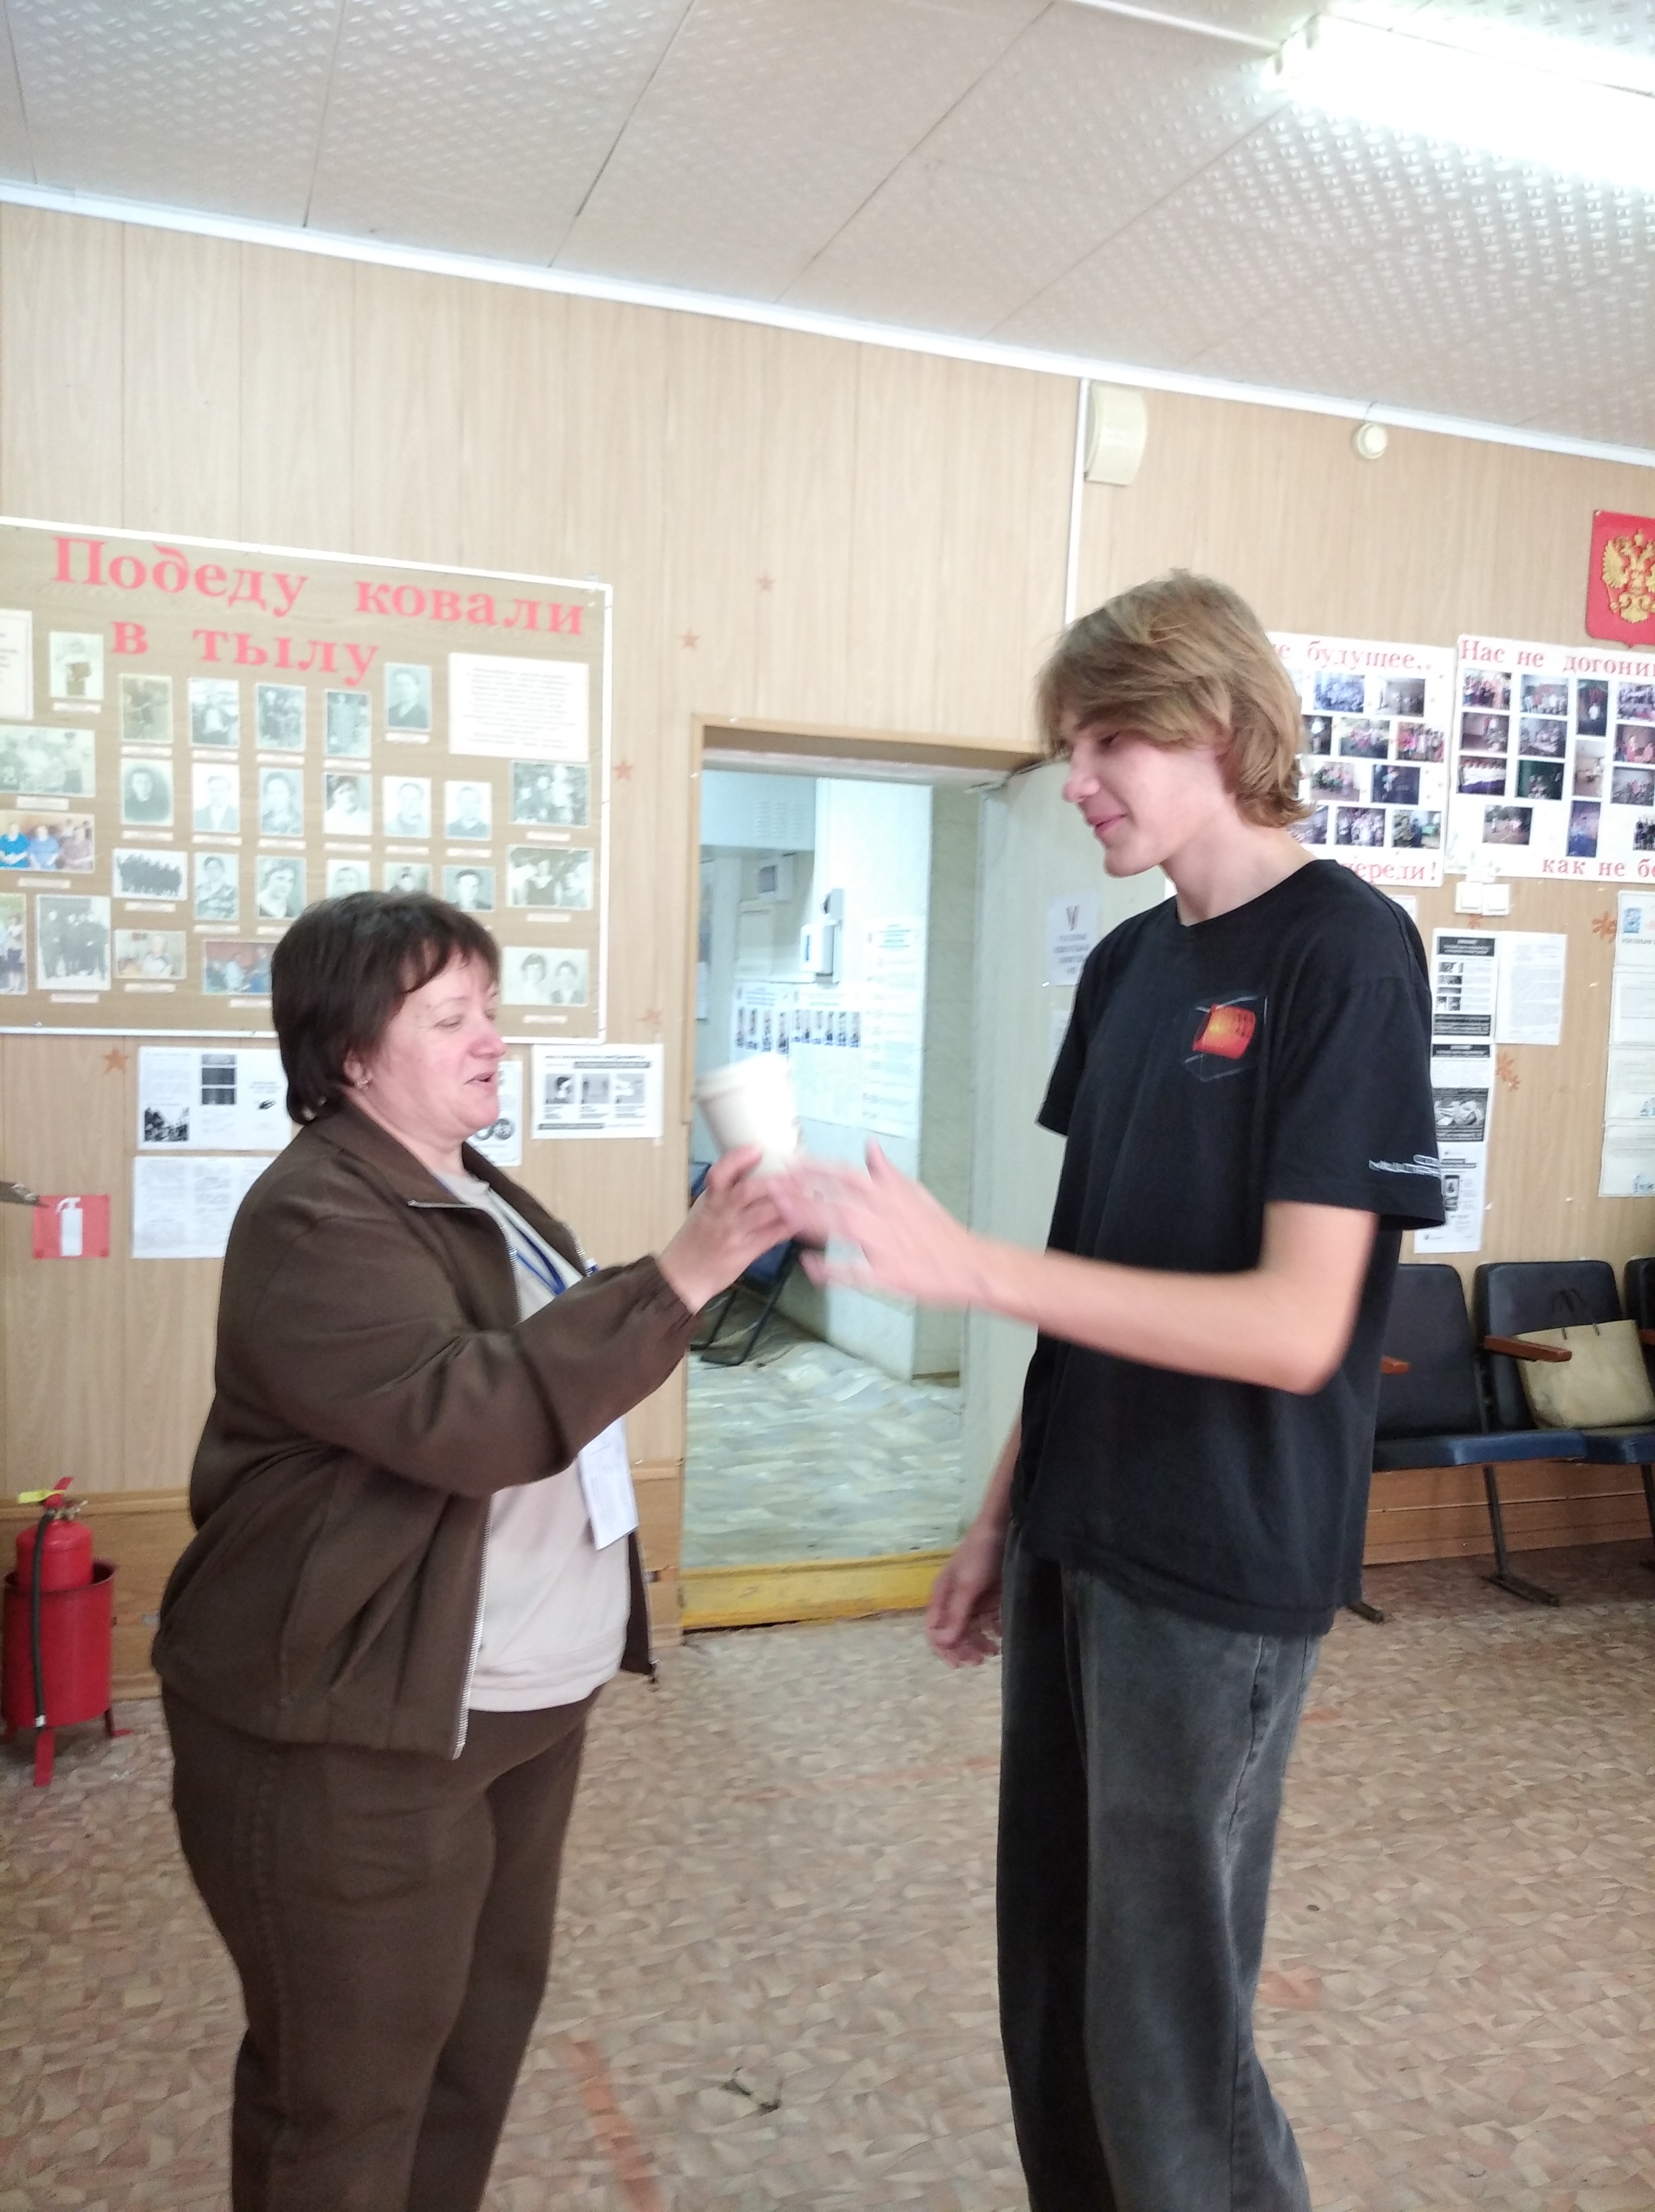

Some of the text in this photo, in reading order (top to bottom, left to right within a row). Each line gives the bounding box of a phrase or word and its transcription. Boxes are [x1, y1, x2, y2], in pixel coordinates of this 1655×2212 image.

[51, 535, 585, 637] Победу ковали
[111, 620, 380, 687] в тылу
[1273, 643, 1291, 659] е
[1461, 640, 1655, 678] Нас не догони
[1542, 859, 1586, 875] как
[1597, 862, 1625, 877] не
